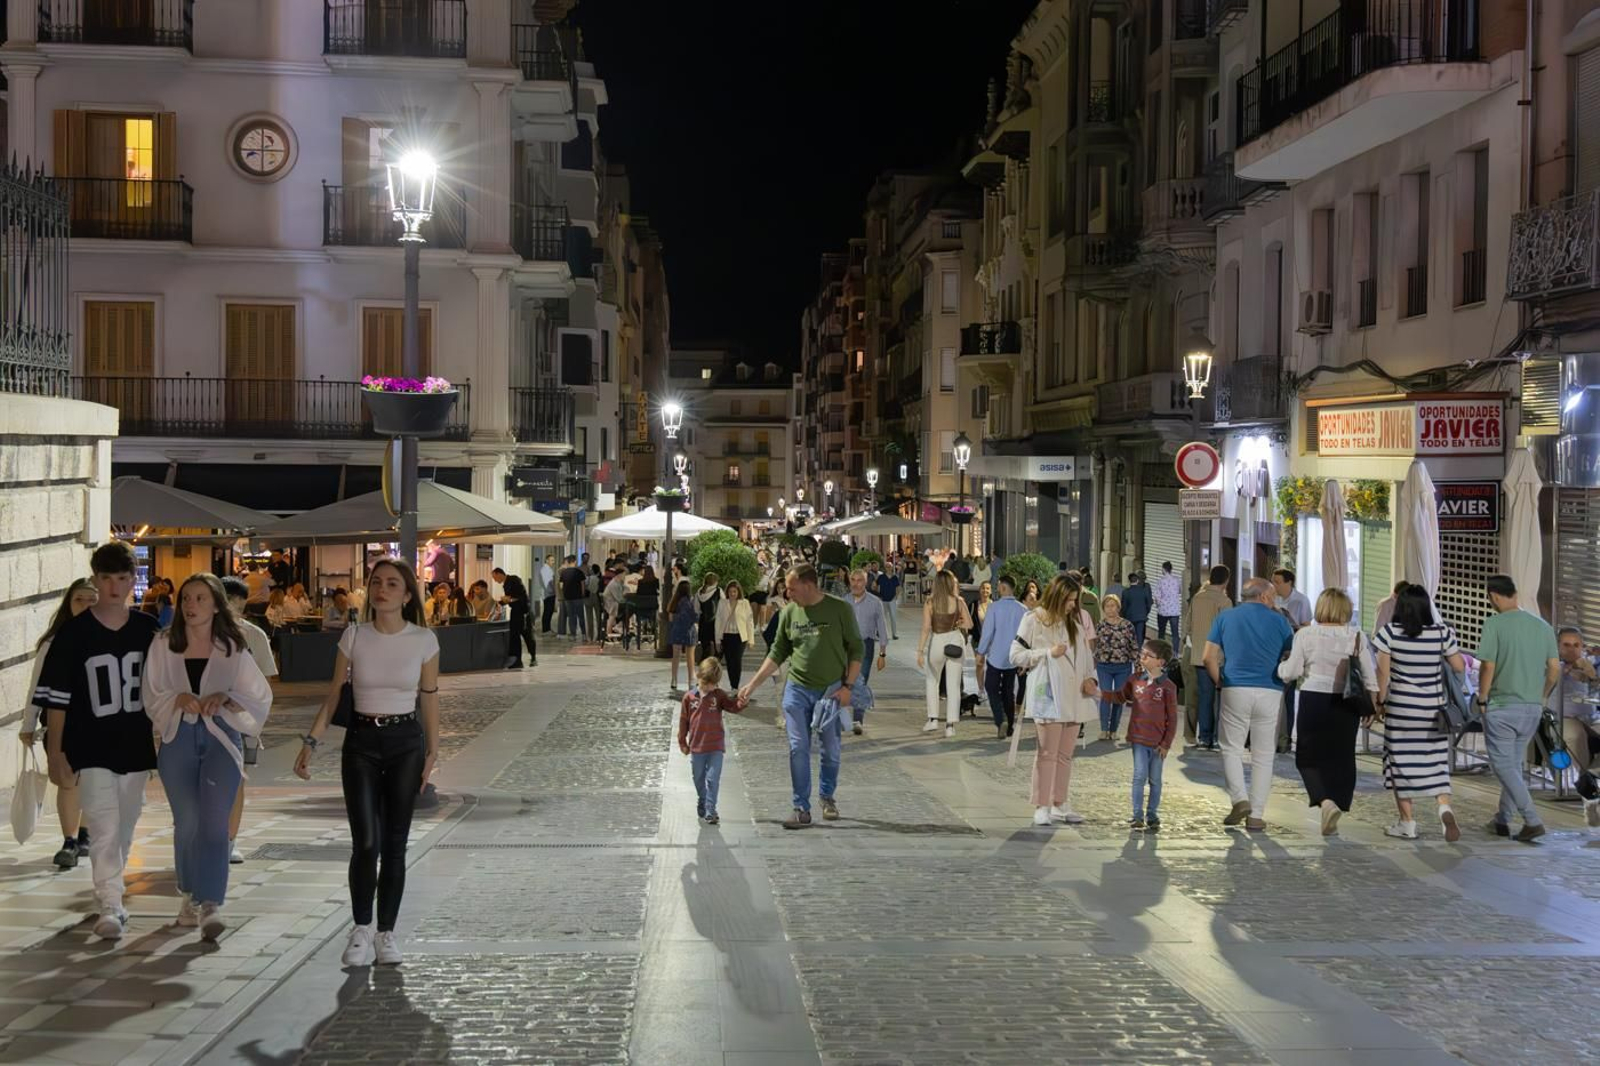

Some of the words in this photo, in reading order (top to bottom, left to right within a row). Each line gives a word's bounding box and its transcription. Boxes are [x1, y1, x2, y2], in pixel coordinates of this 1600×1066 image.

[1419, 405, 1500, 419] OPORTUNIDADES
[1320, 411, 1376, 434] OPORTUNIDADES
[1378, 409, 1412, 449] JAVIER
[1421, 418, 1500, 439] JAVIER
[1320, 438, 1339, 449] TODO
[1340, 438, 1351, 448] EN
[1353, 437, 1376, 448] TELAS
[1420, 439, 1448, 448] TODO
[1451, 439, 1465, 448] EN
[1469, 439, 1501, 447] TELAS
[1438, 500, 1490, 514] AVIER
[84, 651, 144, 718] 08
